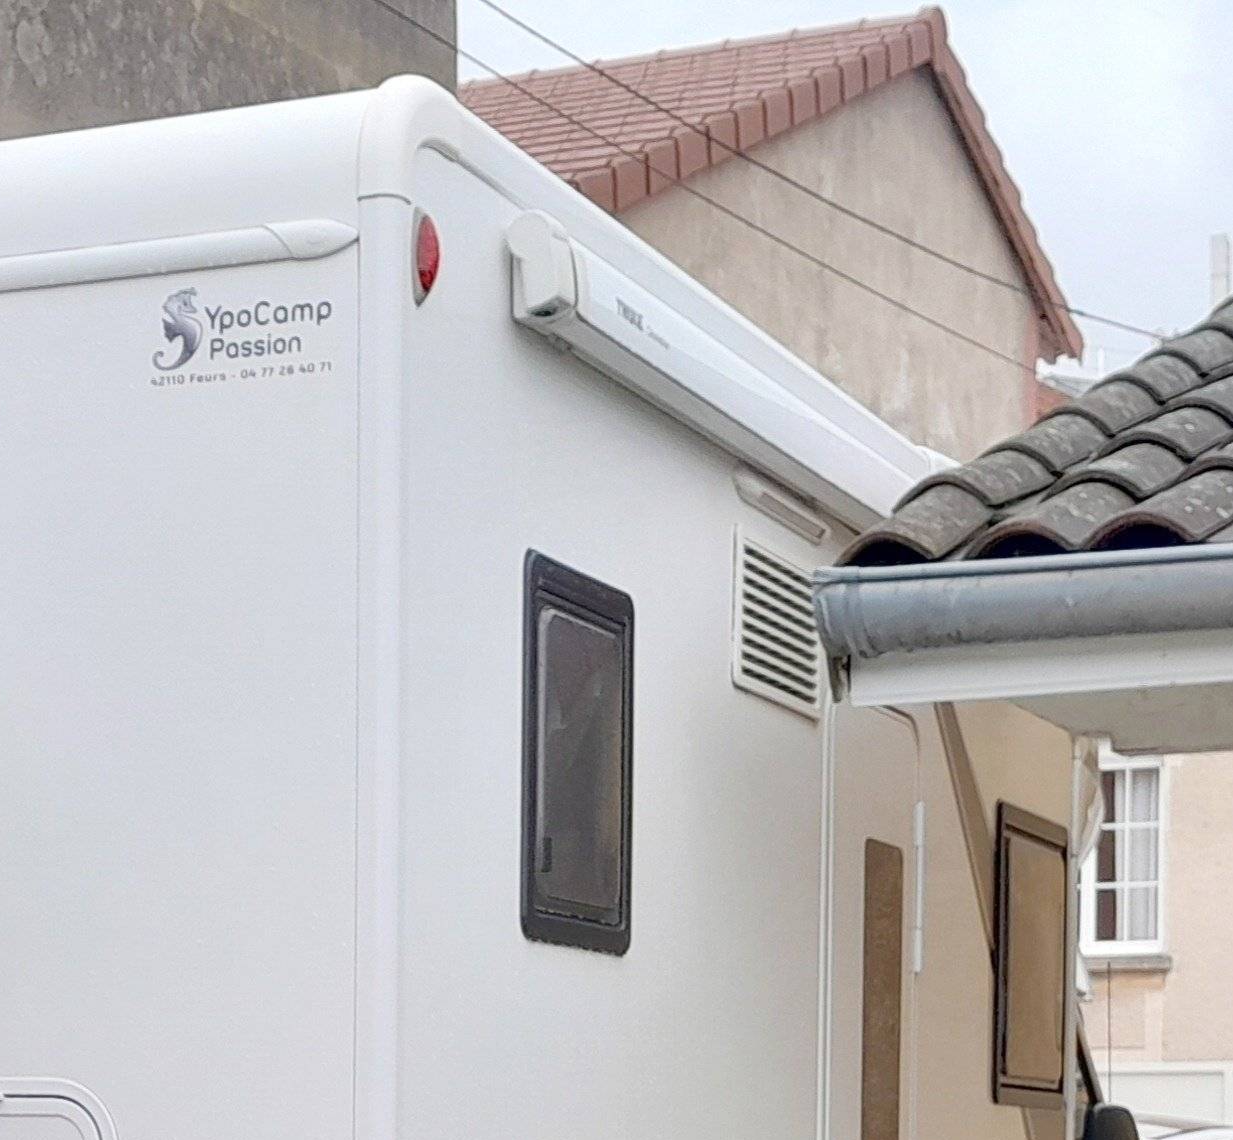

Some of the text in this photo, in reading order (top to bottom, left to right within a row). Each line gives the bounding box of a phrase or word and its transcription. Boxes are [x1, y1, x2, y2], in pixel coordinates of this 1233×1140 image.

[204, 301, 332, 333] YpoCamp
[210, 333, 302, 360] Passion
[190, 373, 226, 382] Feurs
